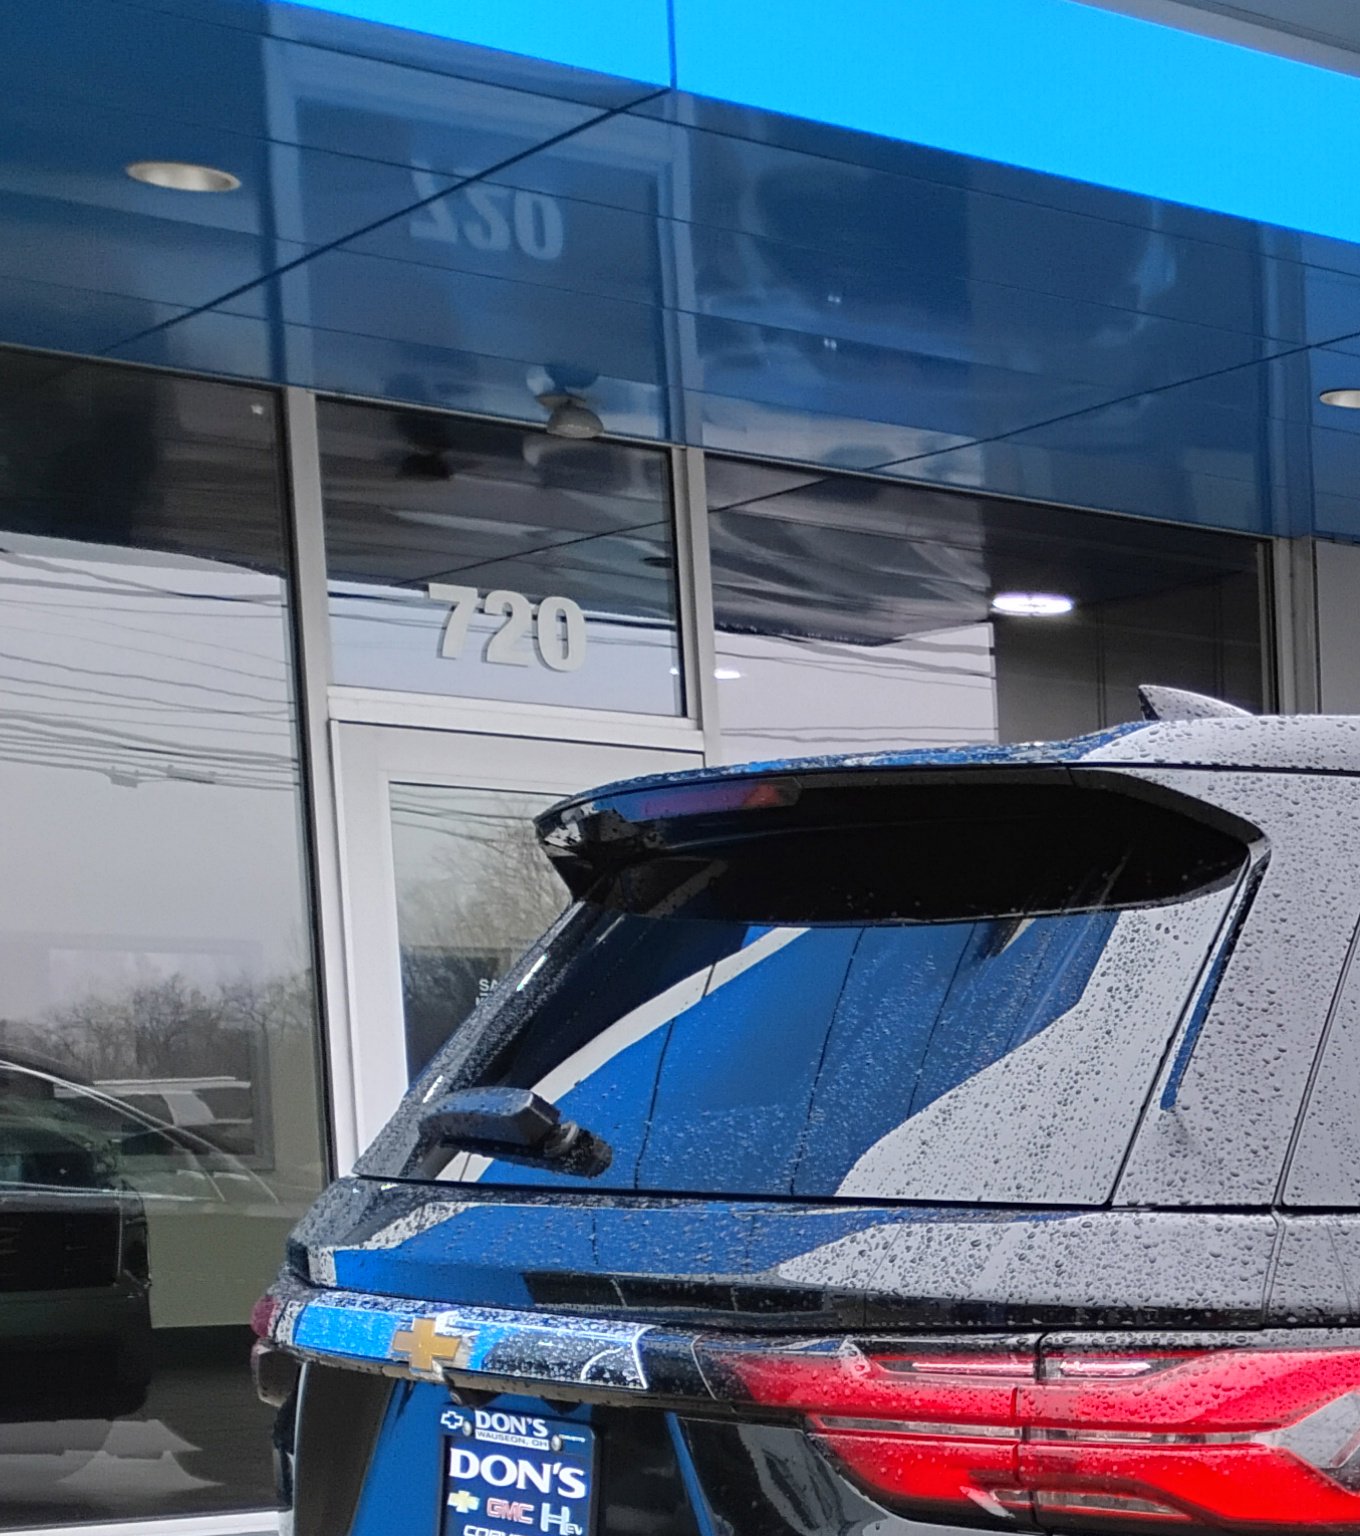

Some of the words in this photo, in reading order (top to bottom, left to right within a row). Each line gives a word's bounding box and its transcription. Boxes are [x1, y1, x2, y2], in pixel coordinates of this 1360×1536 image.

[427, 582, 587, 672] 720
[475, 1410, 549, 1438] DON'S
[477, 1431, 529, 1446] WAUSEON,
[531, 1439, 547, 1448] OH
[449, 1447, 586, 1499] DON'S
[486, 1497, 535, 1524] GMC
